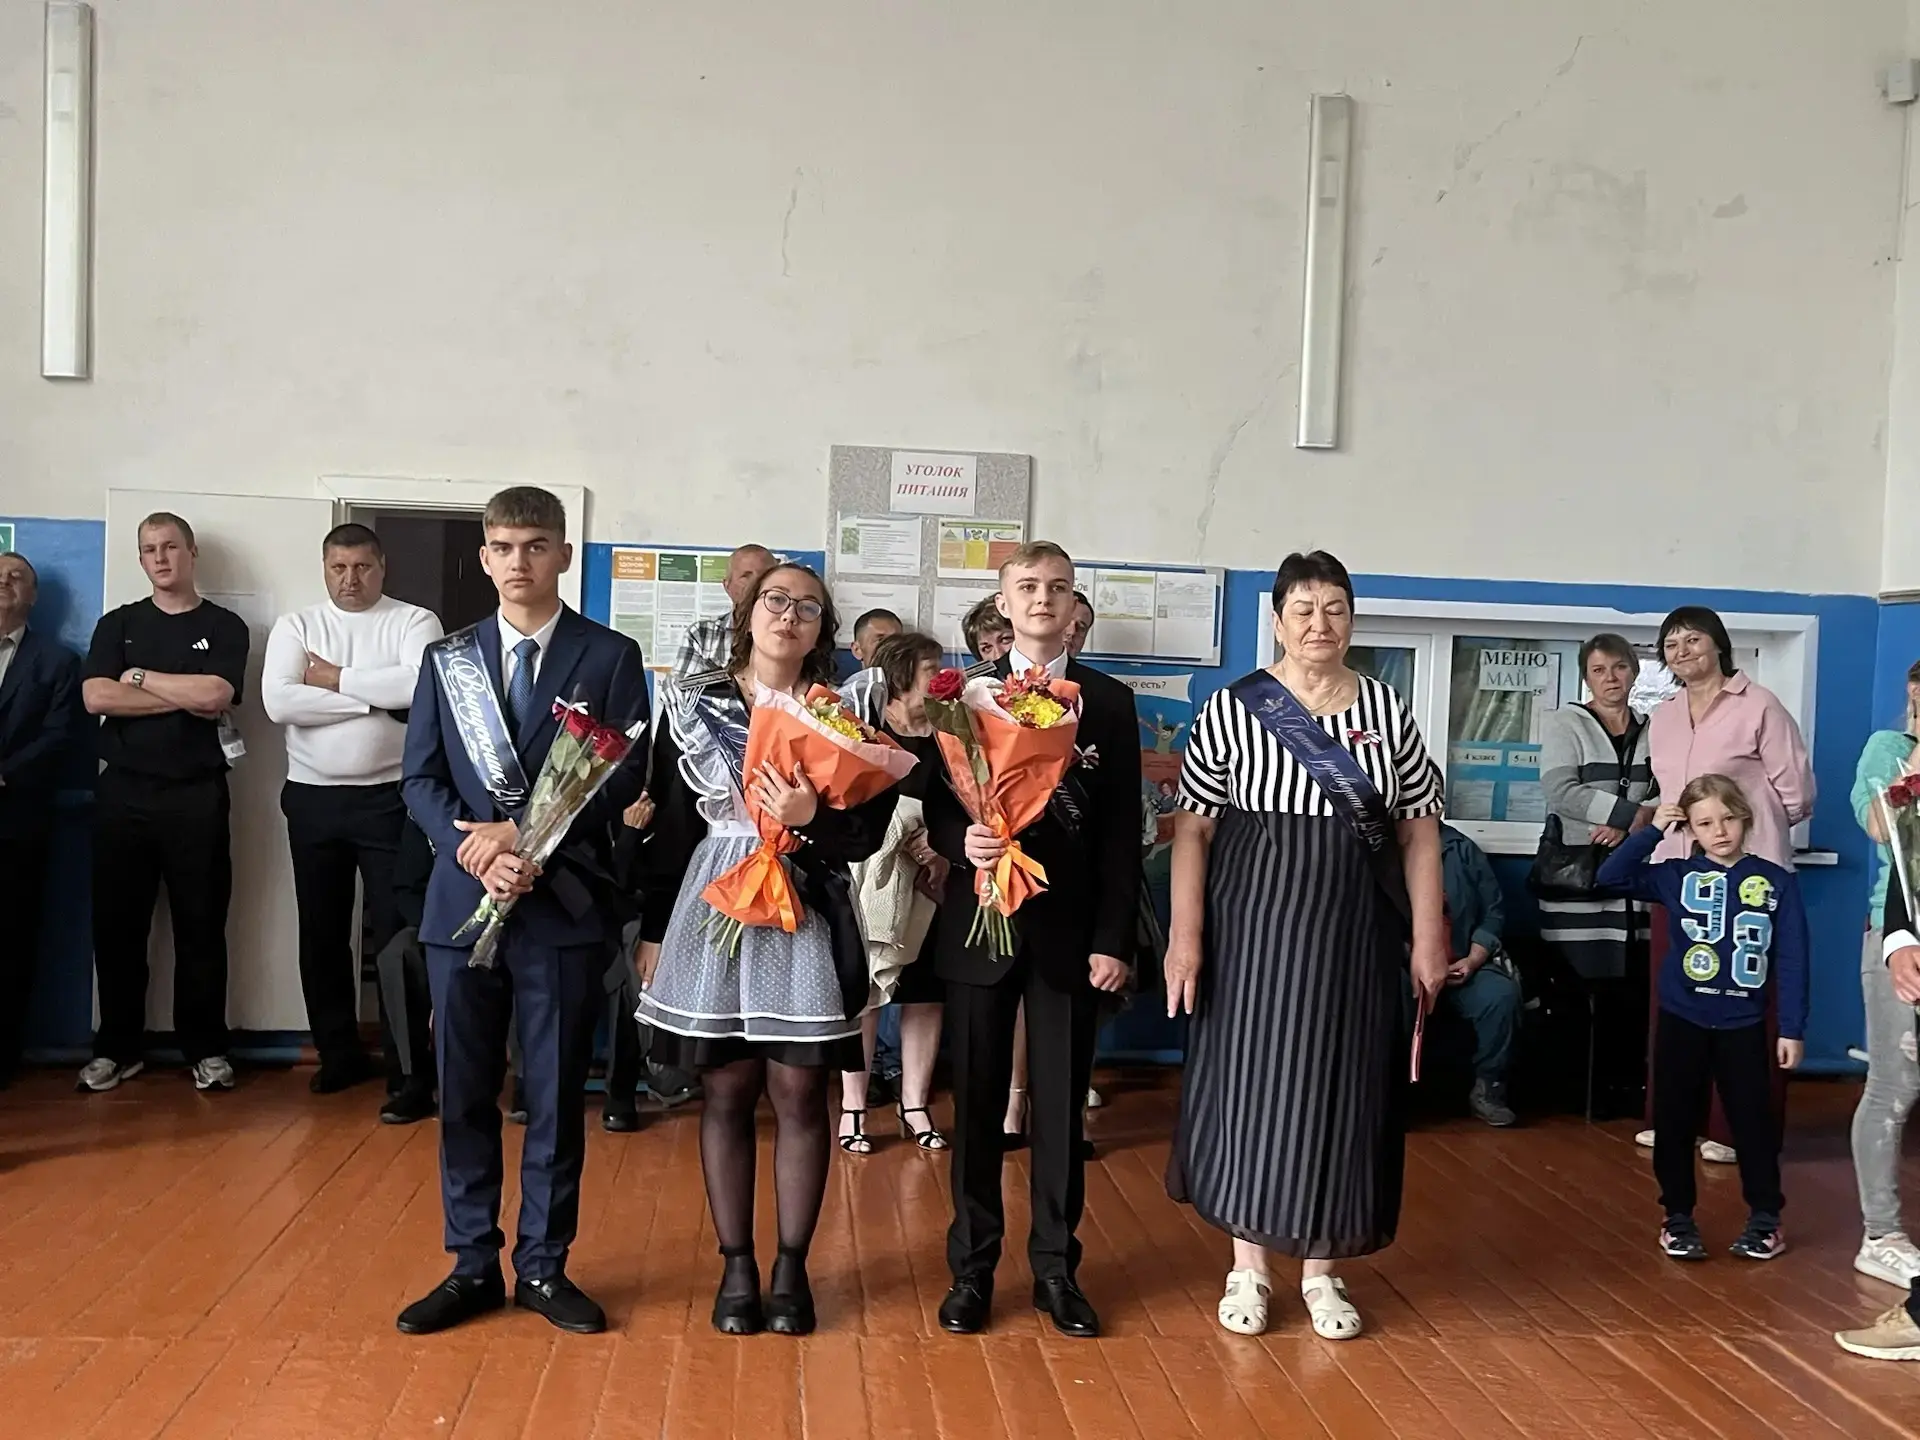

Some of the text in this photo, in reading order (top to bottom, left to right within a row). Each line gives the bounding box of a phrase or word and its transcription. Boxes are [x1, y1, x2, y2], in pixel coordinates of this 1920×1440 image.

[905, 464, 964, 478] УГОЛОК
[896, 483, 969, 498] ПИТАНИЯ
[1484, 651, 1547, 667] МЕНЮ
[1487, 669, 1527, 686] МАЙ
[1140, 681, 1166, 690] есть?
[448, 656, 509, 785] Выпускник
